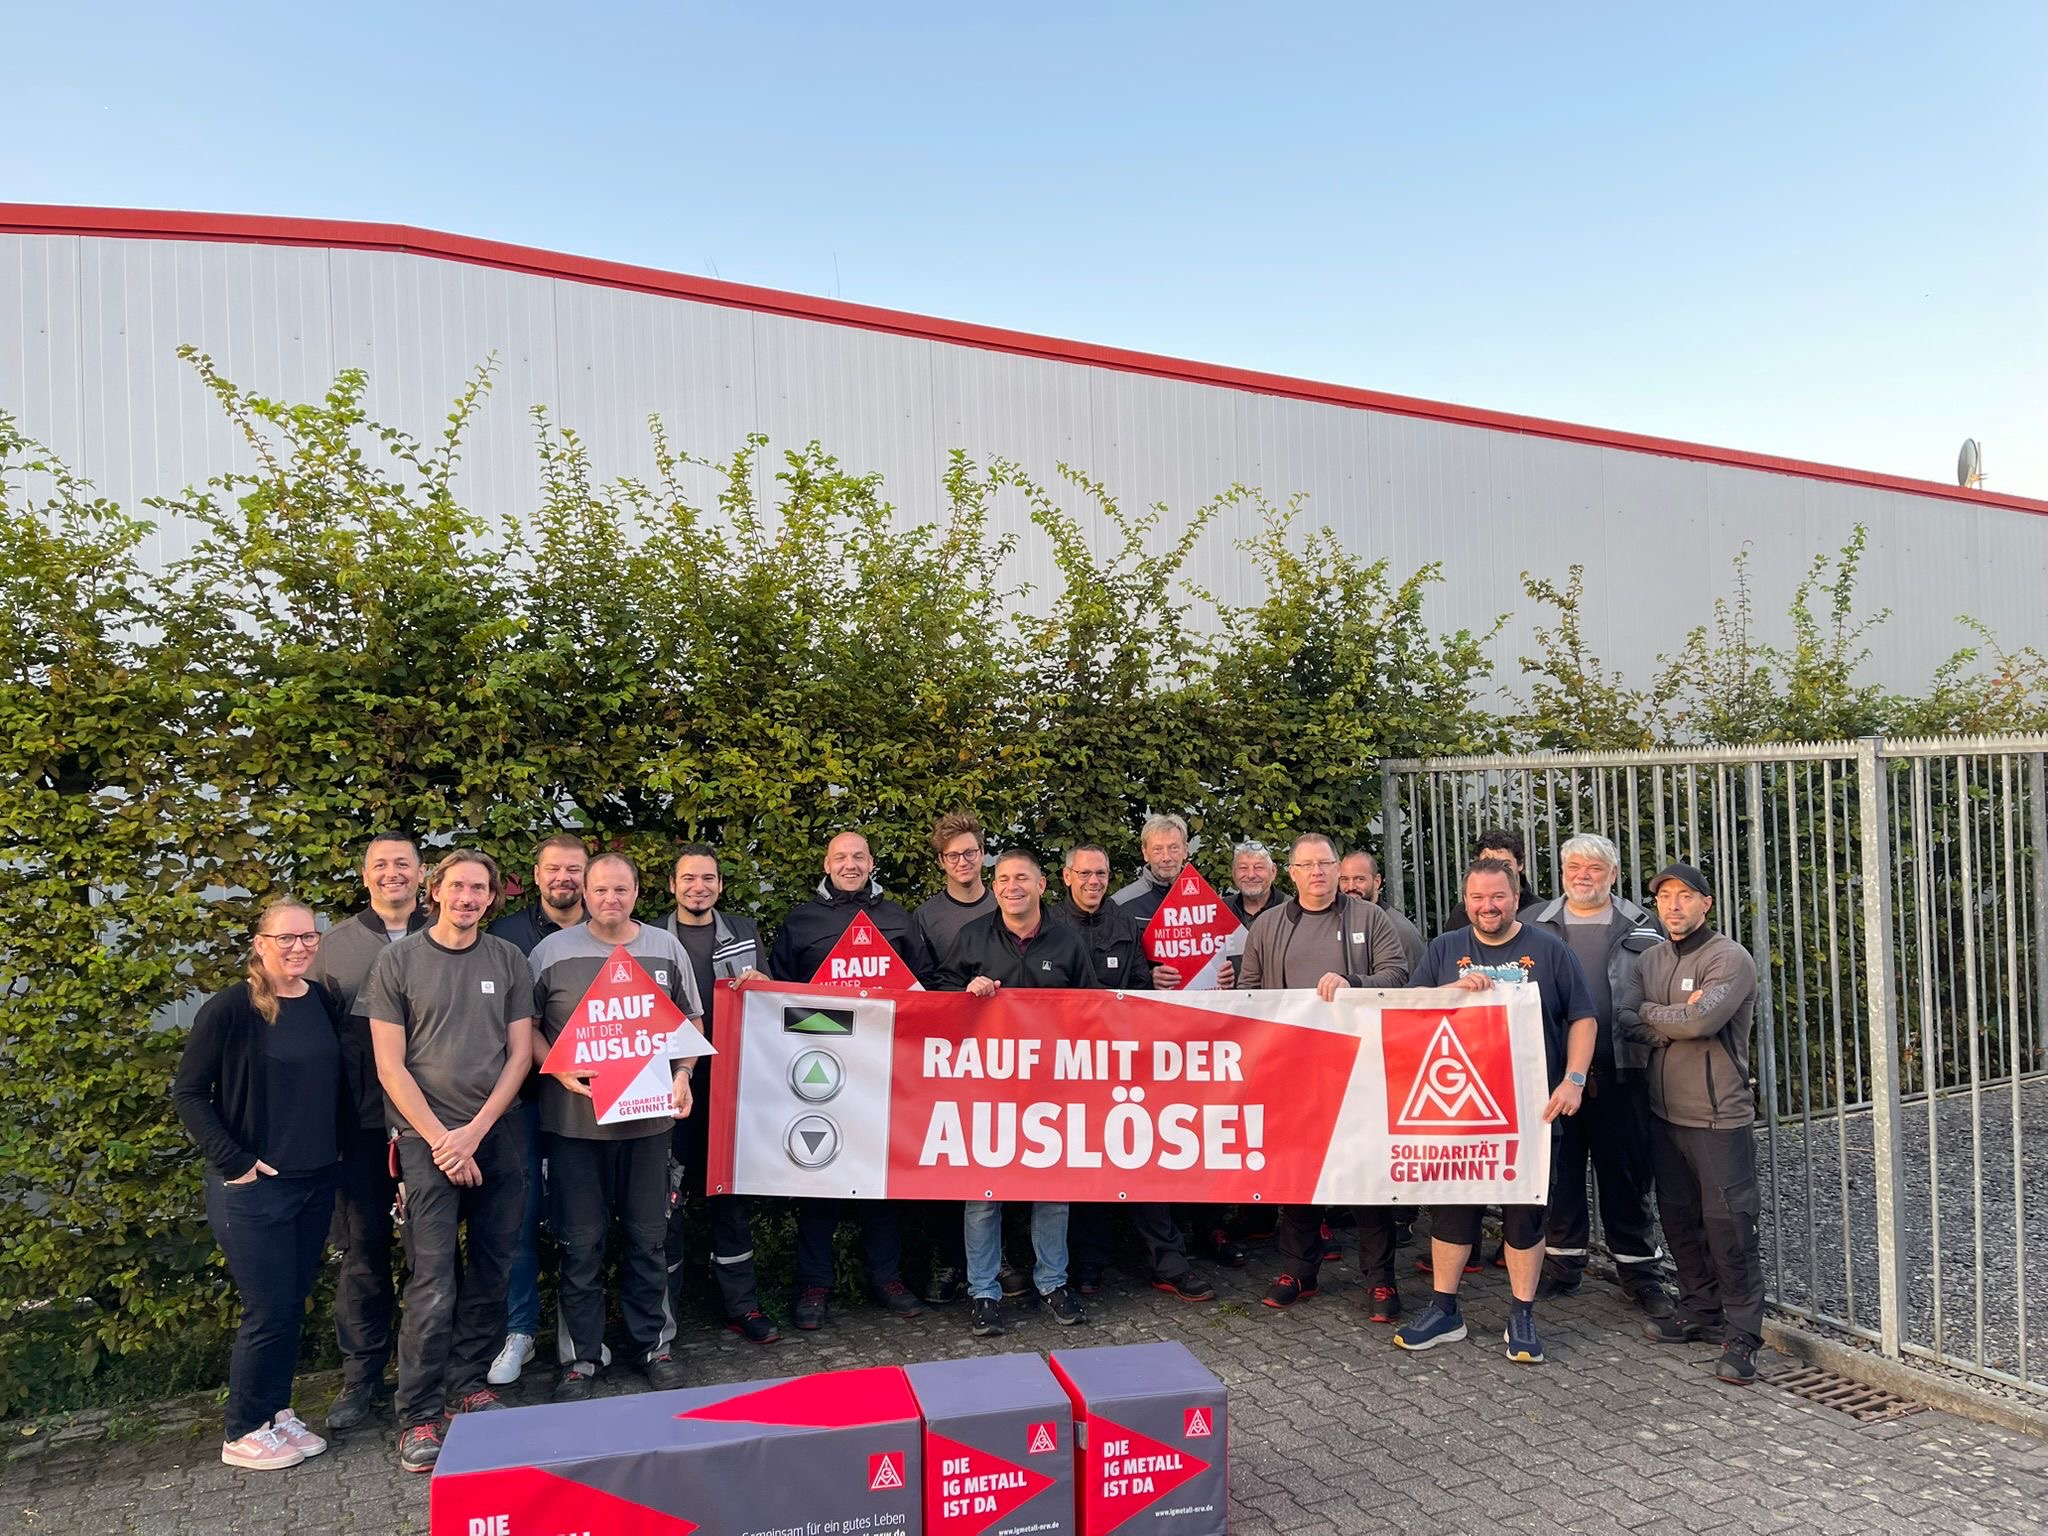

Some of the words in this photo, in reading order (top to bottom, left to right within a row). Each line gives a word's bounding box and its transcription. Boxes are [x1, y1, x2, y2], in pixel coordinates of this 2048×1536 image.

[1163, 904, 1217, 927] RAUF
[1154, 929, 1170, 939] MIT
[1173, 927, 1192, 938] DER
[1154, 932, 1235, 958] AUSLÖSE
[831, 956, 891, 979] RAUF
[587, 993, 655, 1023] RAUF
[576, 1025, 597, 1040] MIT
[600, 1023, 623, 1038] DER
[574, 1029, 680, 1064] AUSLÖSE
[922, 1037, 1042, 1080] RAUF
[1053, 1039, 1140, 1081] MIT
[1153, 1040, 1244, 1082] DER
[618, 1095, 665, 1108] SOLIDARITÄT
[918, 1085, 1266, 1171] AUSLÖSE!
[1391, 1140, 1500, 1160] SOLIDARITÄT
[1103, 1440, 1129, 1458] DIE
[942, 1457, 970, 1476] DIE
[1104, 1461, 1120, 1478] IG
[1123, 1453, 1183, 1475] METALL
[943, 1479, 960, 1497] IG
[964, 1471, 1027, 1495] METALL
[1103, 1479, 1128, 1498] IST
[1132, 1476, 1154, 1495] DA
[943, 1498, 970, 1518] IST
[974, 1495, 997, 1514] DA
[469, 1513, 510, 1536] DIE
[807, 1521, 821, 1536] für
[824, 1519, 840, 1533] ein
[842, 1516, 871, 1534] gutes
[874, 1511, 906, 1527] Leben
